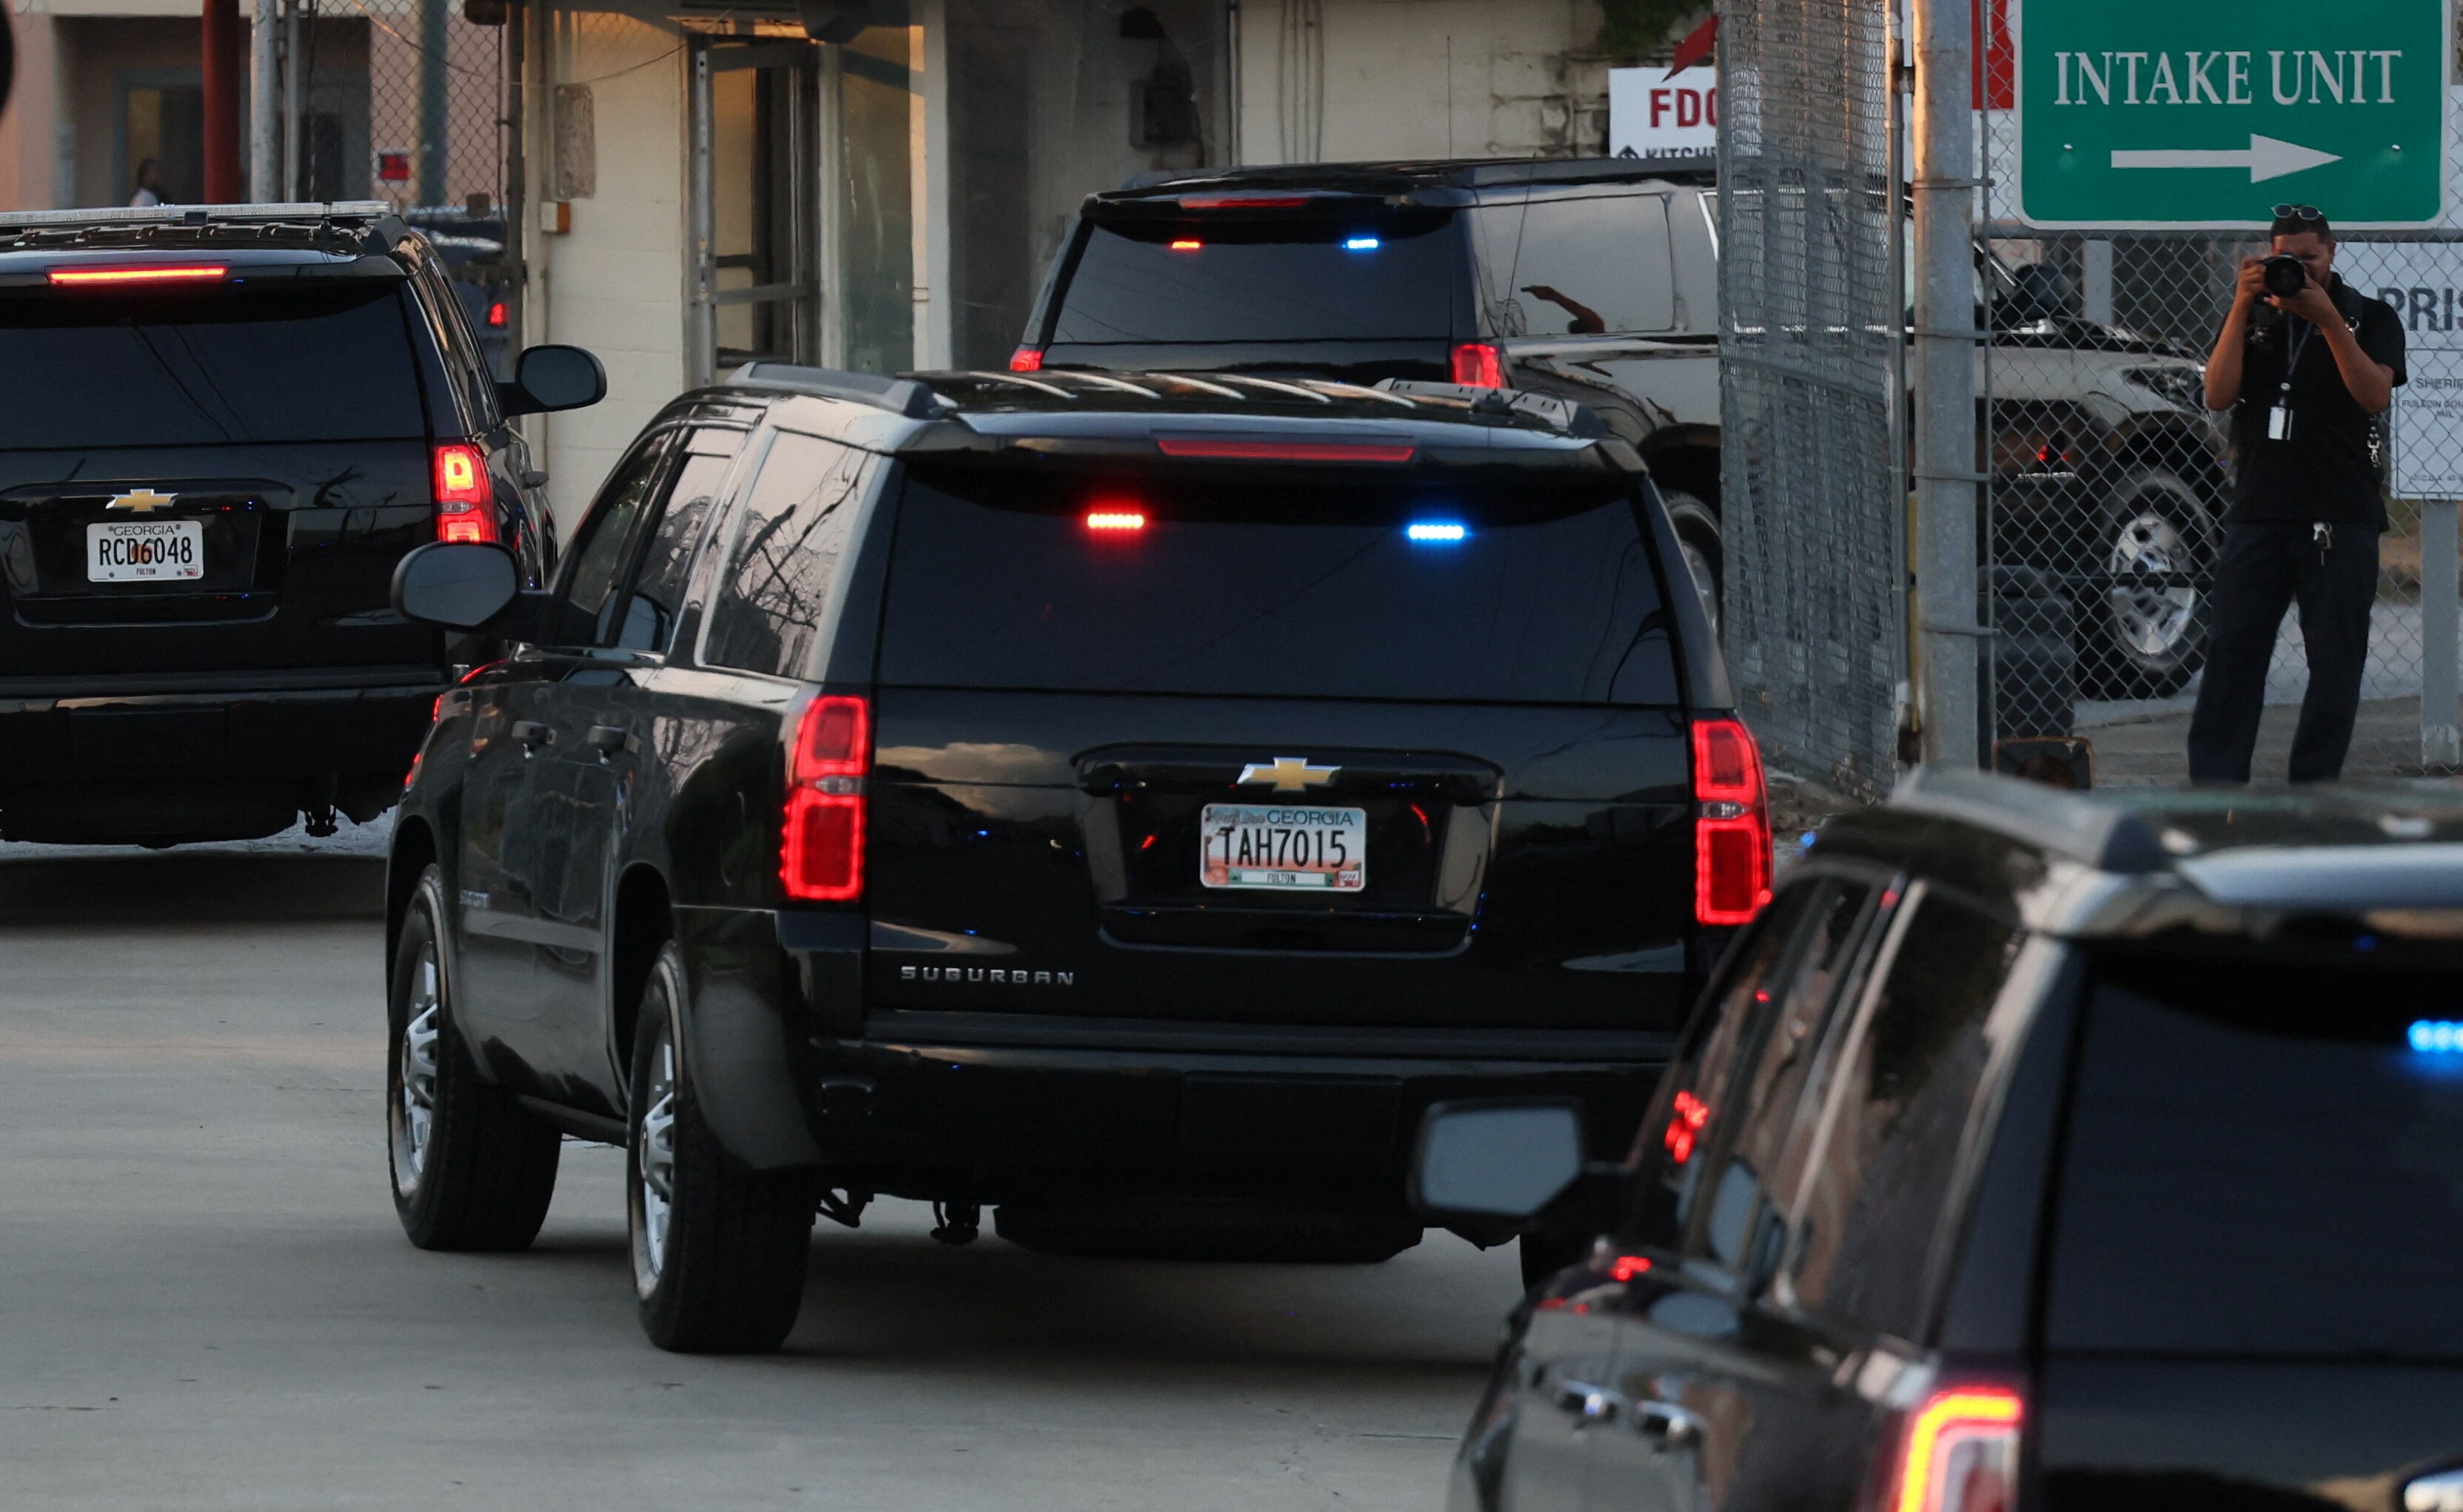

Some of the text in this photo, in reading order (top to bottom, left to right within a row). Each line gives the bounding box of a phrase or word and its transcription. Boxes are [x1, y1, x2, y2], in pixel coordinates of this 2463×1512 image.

[2054, 50, 2403, 105] INTAKE UNIT
[2376, 286, 2463, 332] PRI
[113, 525, 175, 537] GEORGIA
[99, 536, 192, 566] RCD6048
[136, 568, 156, 576] FULTON
[1267, 810, 1353, 827] GEORGIA
[1219, 826, 1347, 868] TAH7015
[1267, 872, 1296, 883] FULTON
[901, 966, 1073, 985] SUBURBAN
